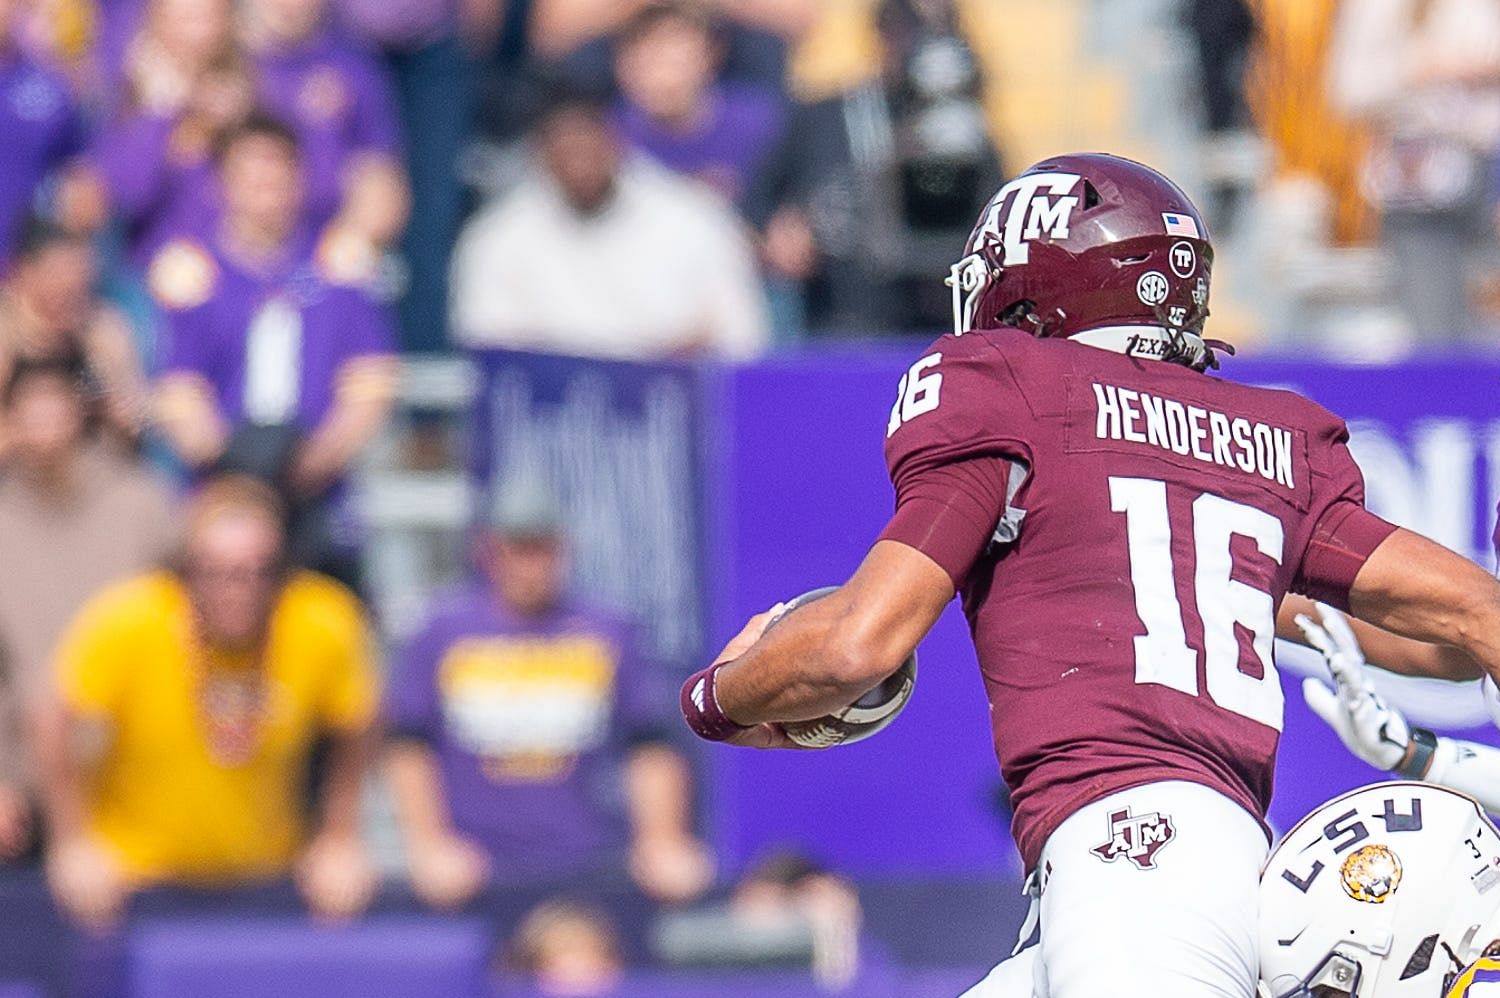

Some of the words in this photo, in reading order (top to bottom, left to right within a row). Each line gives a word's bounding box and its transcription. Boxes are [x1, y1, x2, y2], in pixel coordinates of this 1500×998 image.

[886, 351, 943, 438] 16
[1092, 383, 1295, 489] HENDERSON
[1108, 476, 1285, 733] 16
[1282, 798, 1422, 894] LSU
